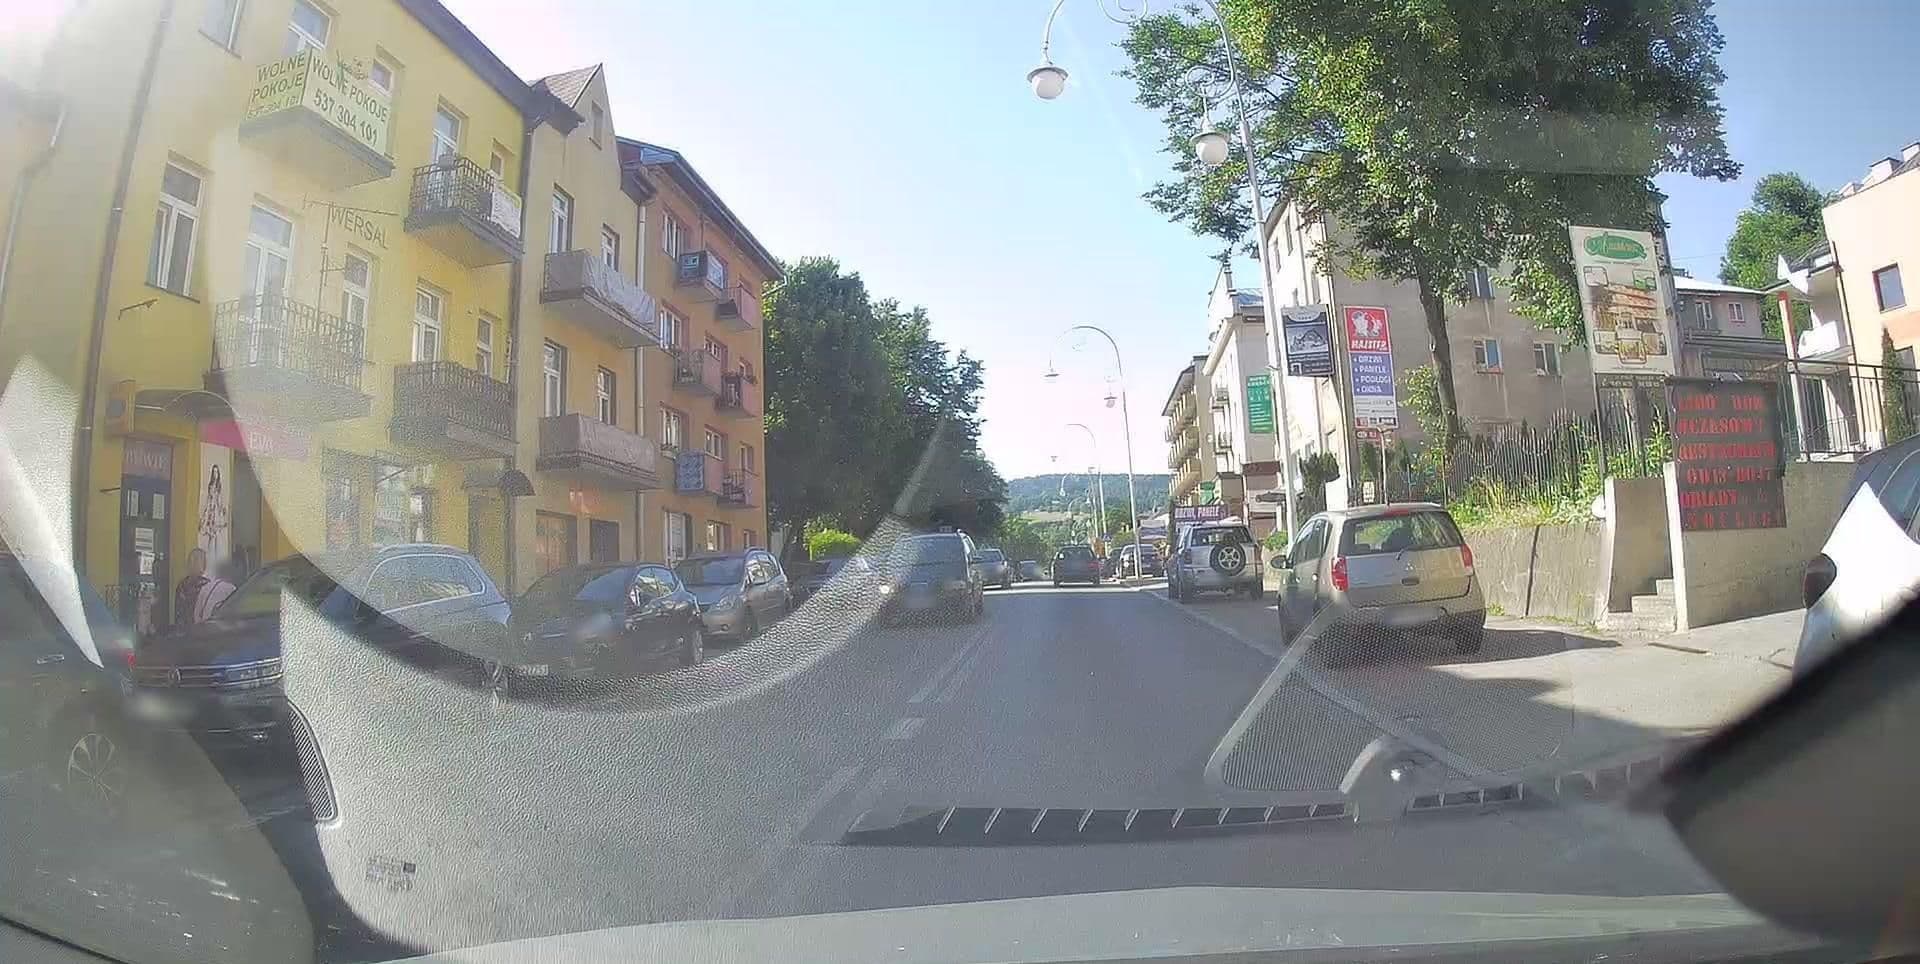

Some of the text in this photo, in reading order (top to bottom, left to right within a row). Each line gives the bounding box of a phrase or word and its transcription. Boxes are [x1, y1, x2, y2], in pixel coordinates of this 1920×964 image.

[258, 52, 306, 82] WOLNE
[251, 72, 304, 103] POKOJE
[312, 55, 389, 123] WOLNE POKOJE
[313, 88, 378, 145] 537 304 101
[331, 206, 389, 250] WERSAL
[1361, 385, 1382, 393] OKNA
